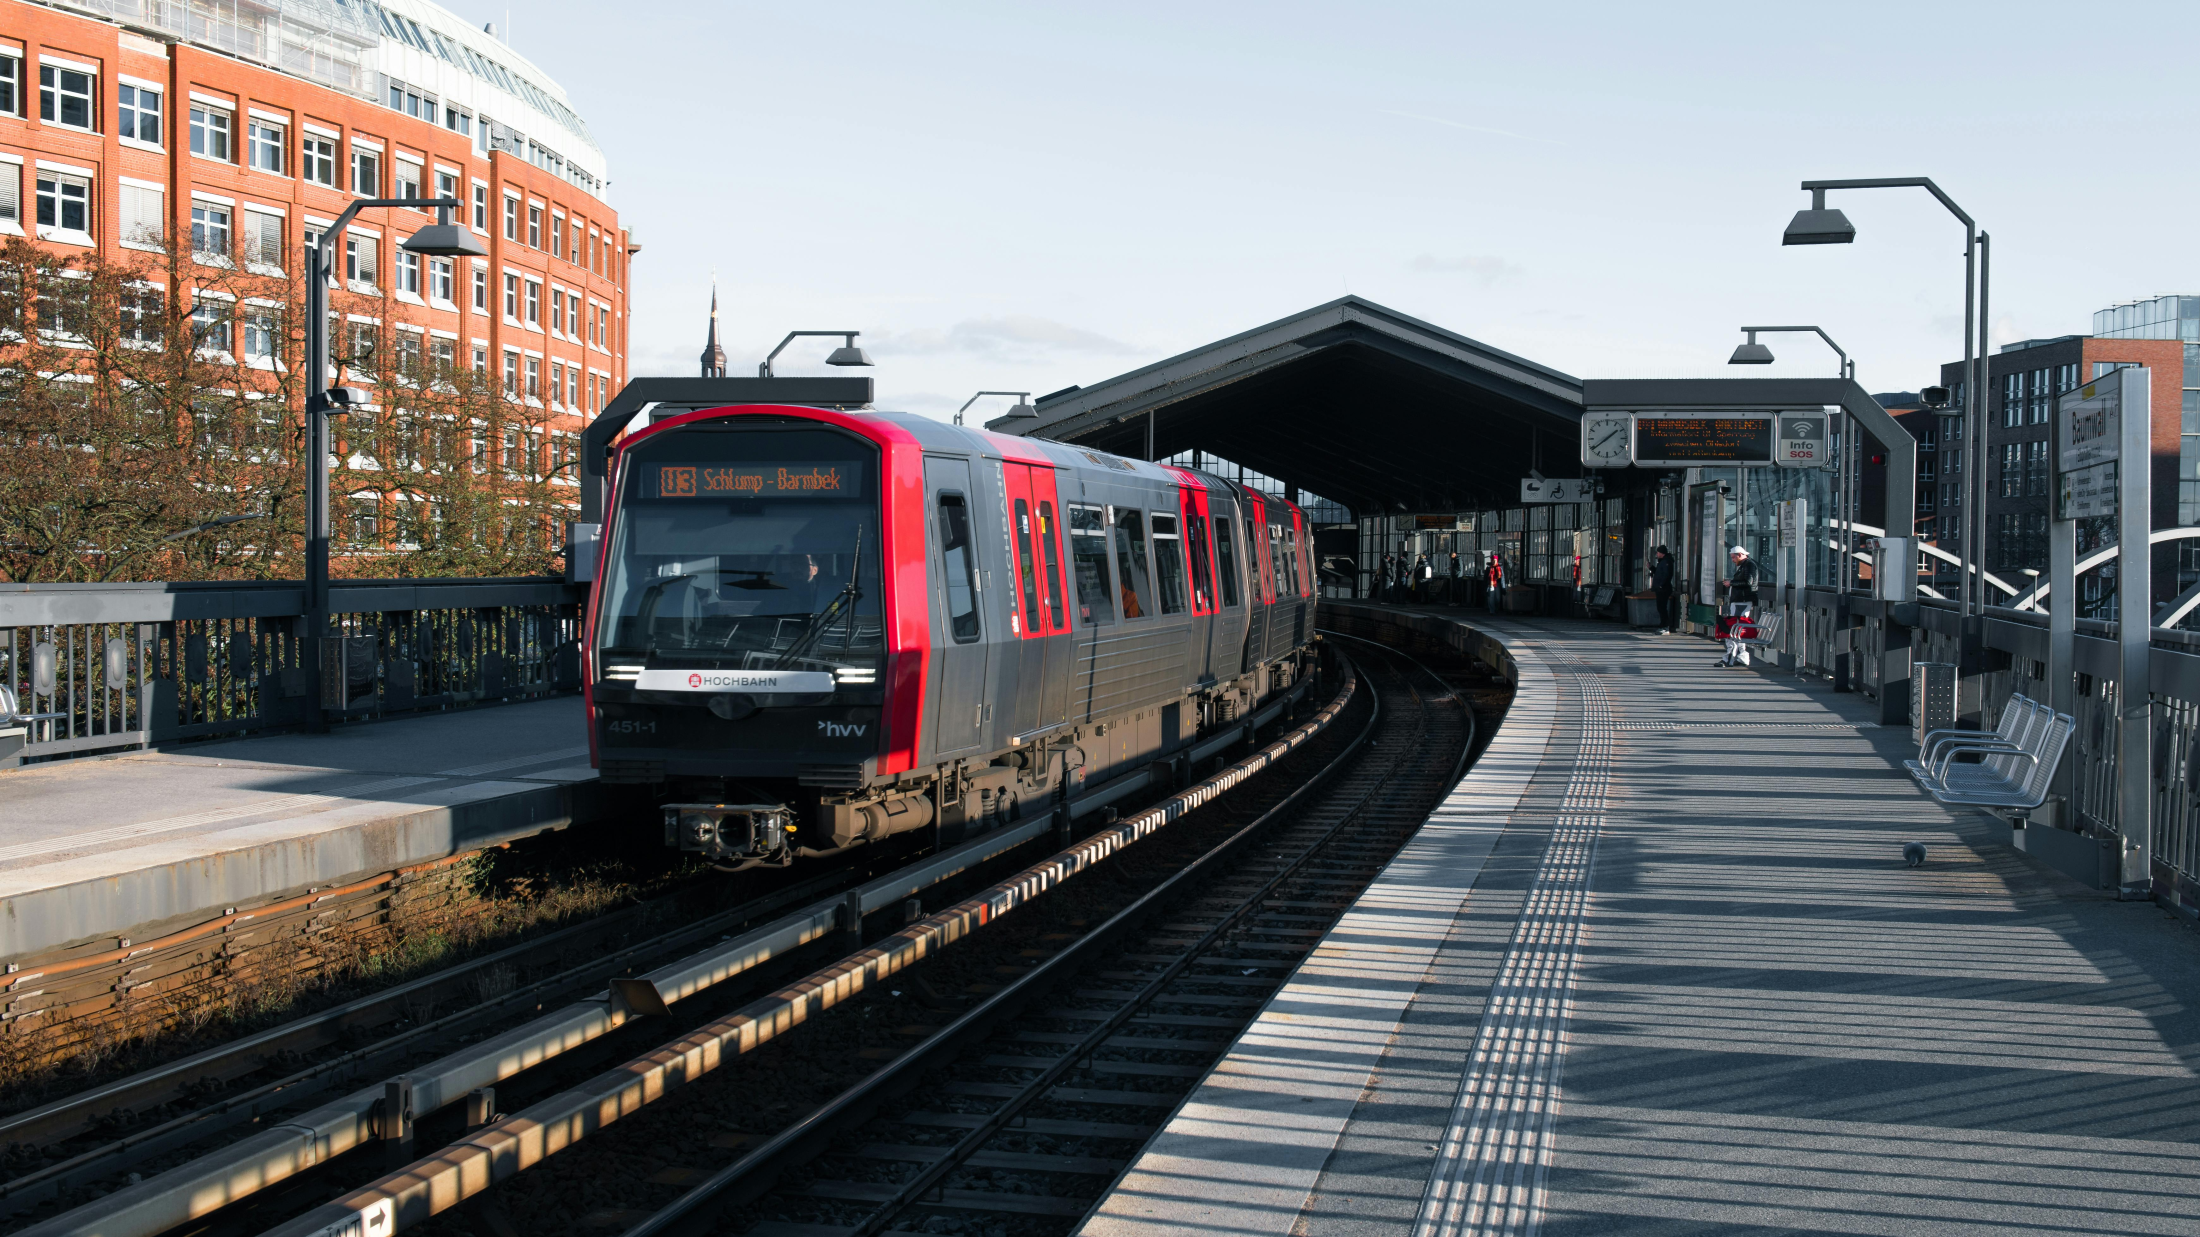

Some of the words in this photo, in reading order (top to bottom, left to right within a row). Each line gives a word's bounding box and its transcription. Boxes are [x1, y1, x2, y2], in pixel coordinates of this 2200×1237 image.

[2072, 398, 2107, 446] Baumwall
[1790, 441, 1814, 450] Info
[1789, 450, 1813, 459] SOS
[662, 468, 695, 495] U3
[703, 468, 763, 493] Schlump
[777, 468, 841, 490] Barmbek
[995, 463, 1016, 607] HOCHBAHN
[703, 675, 778, 687] HOCHBAHN
[608, 720, 657, 734] 451-1
